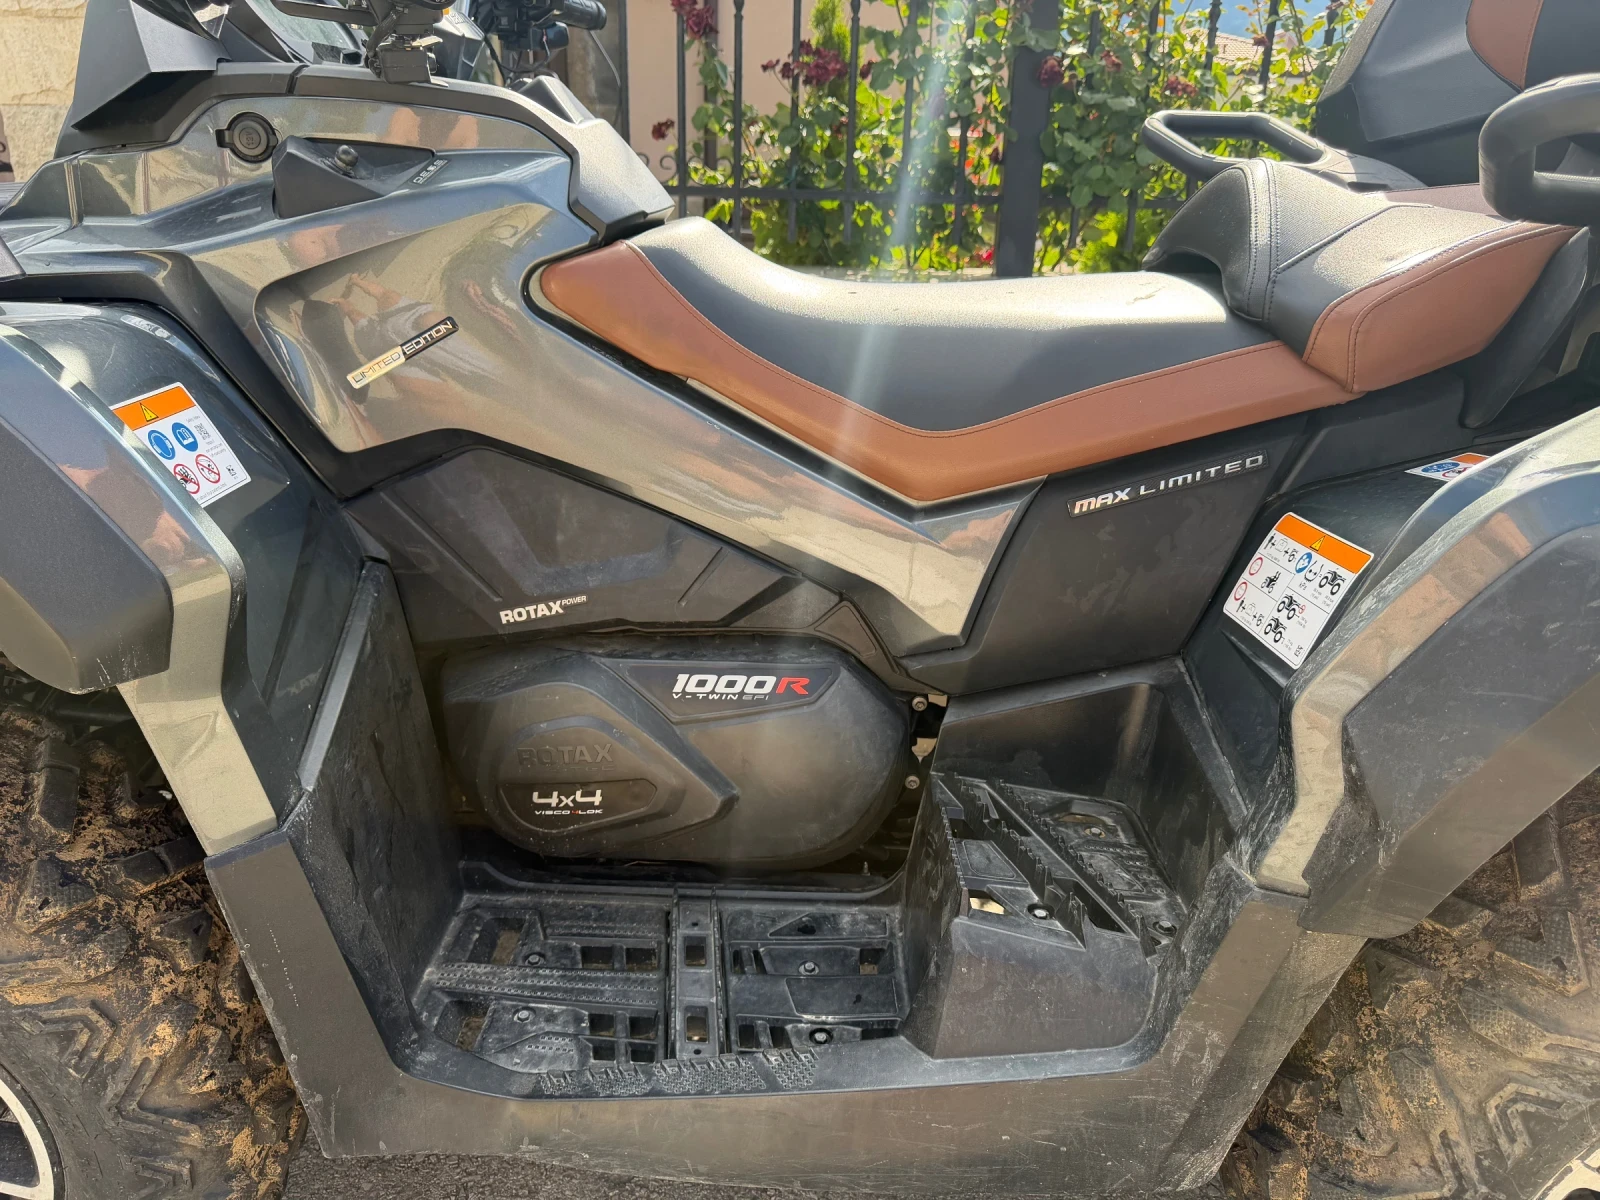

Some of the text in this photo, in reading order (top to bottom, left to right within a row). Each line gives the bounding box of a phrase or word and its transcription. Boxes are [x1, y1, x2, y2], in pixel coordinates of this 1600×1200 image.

[351, 320, 453, 384] LIMITED EDITION
[1073, 454, 1264, 515] MAX LIMITED
[499, 595, 587, 625] ROTAX POWER
[672, 673, 810, 695] 1000R
[516, 743, 614, 766] ROTAX
[532, 789, 603, 808] 4x4
